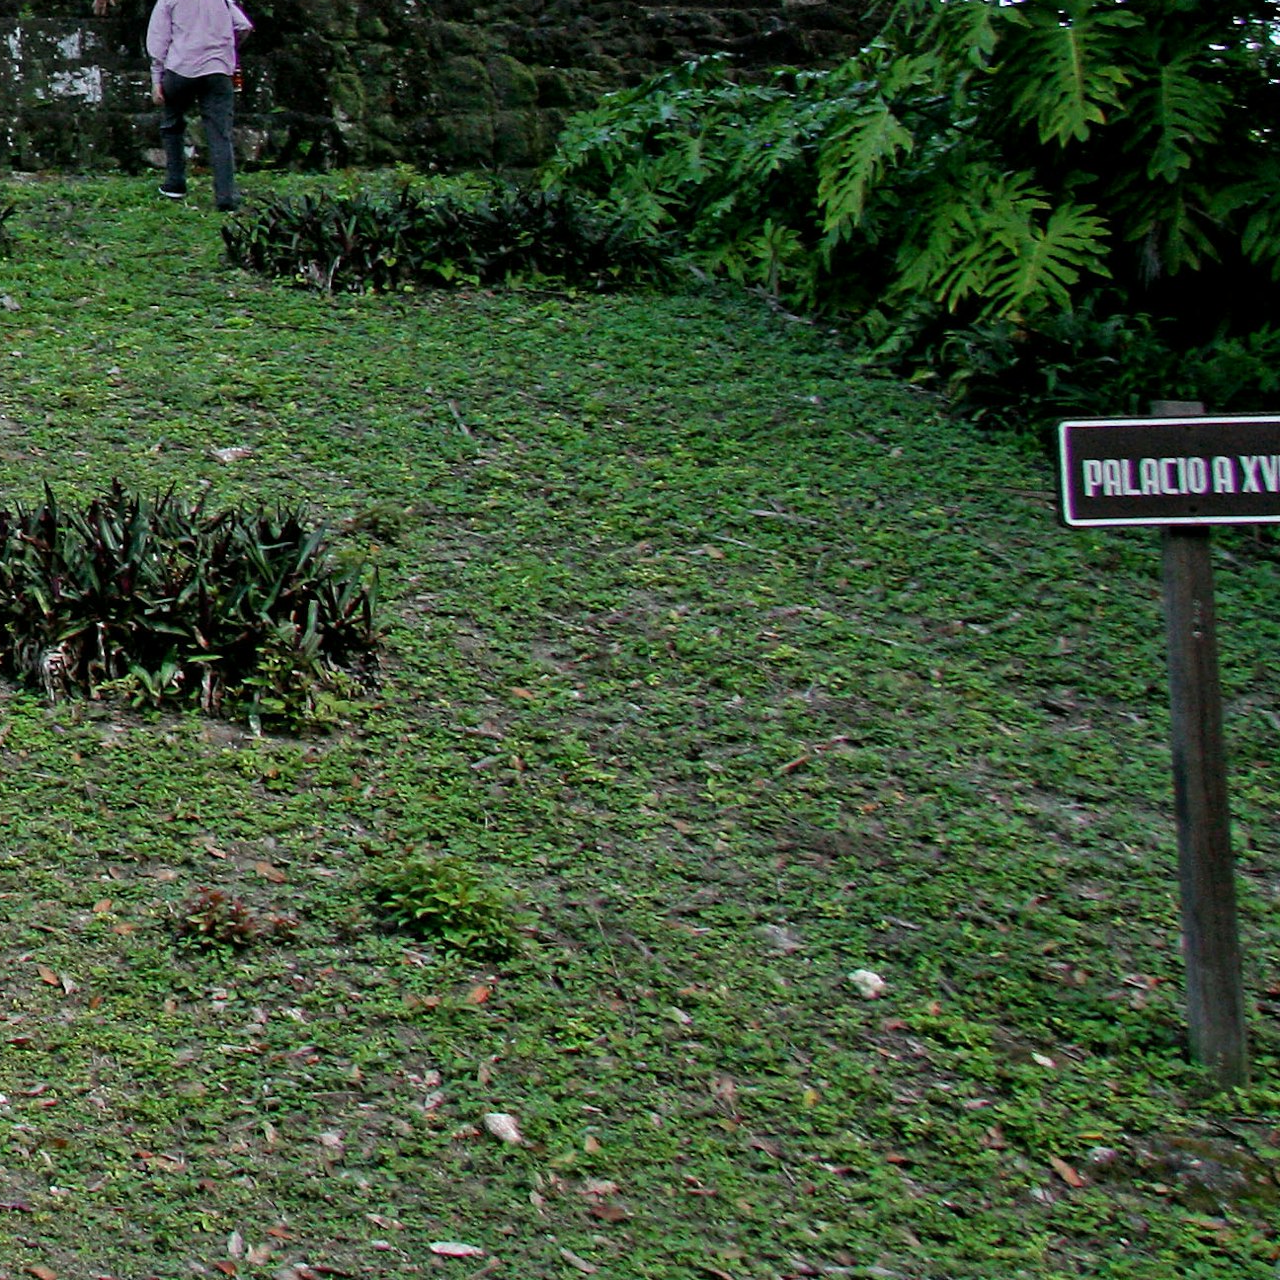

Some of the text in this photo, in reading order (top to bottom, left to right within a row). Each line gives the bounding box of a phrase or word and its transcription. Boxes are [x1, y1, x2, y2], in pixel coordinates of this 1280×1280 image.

[1082, 454, 1280, 497] PALACIO A XV
